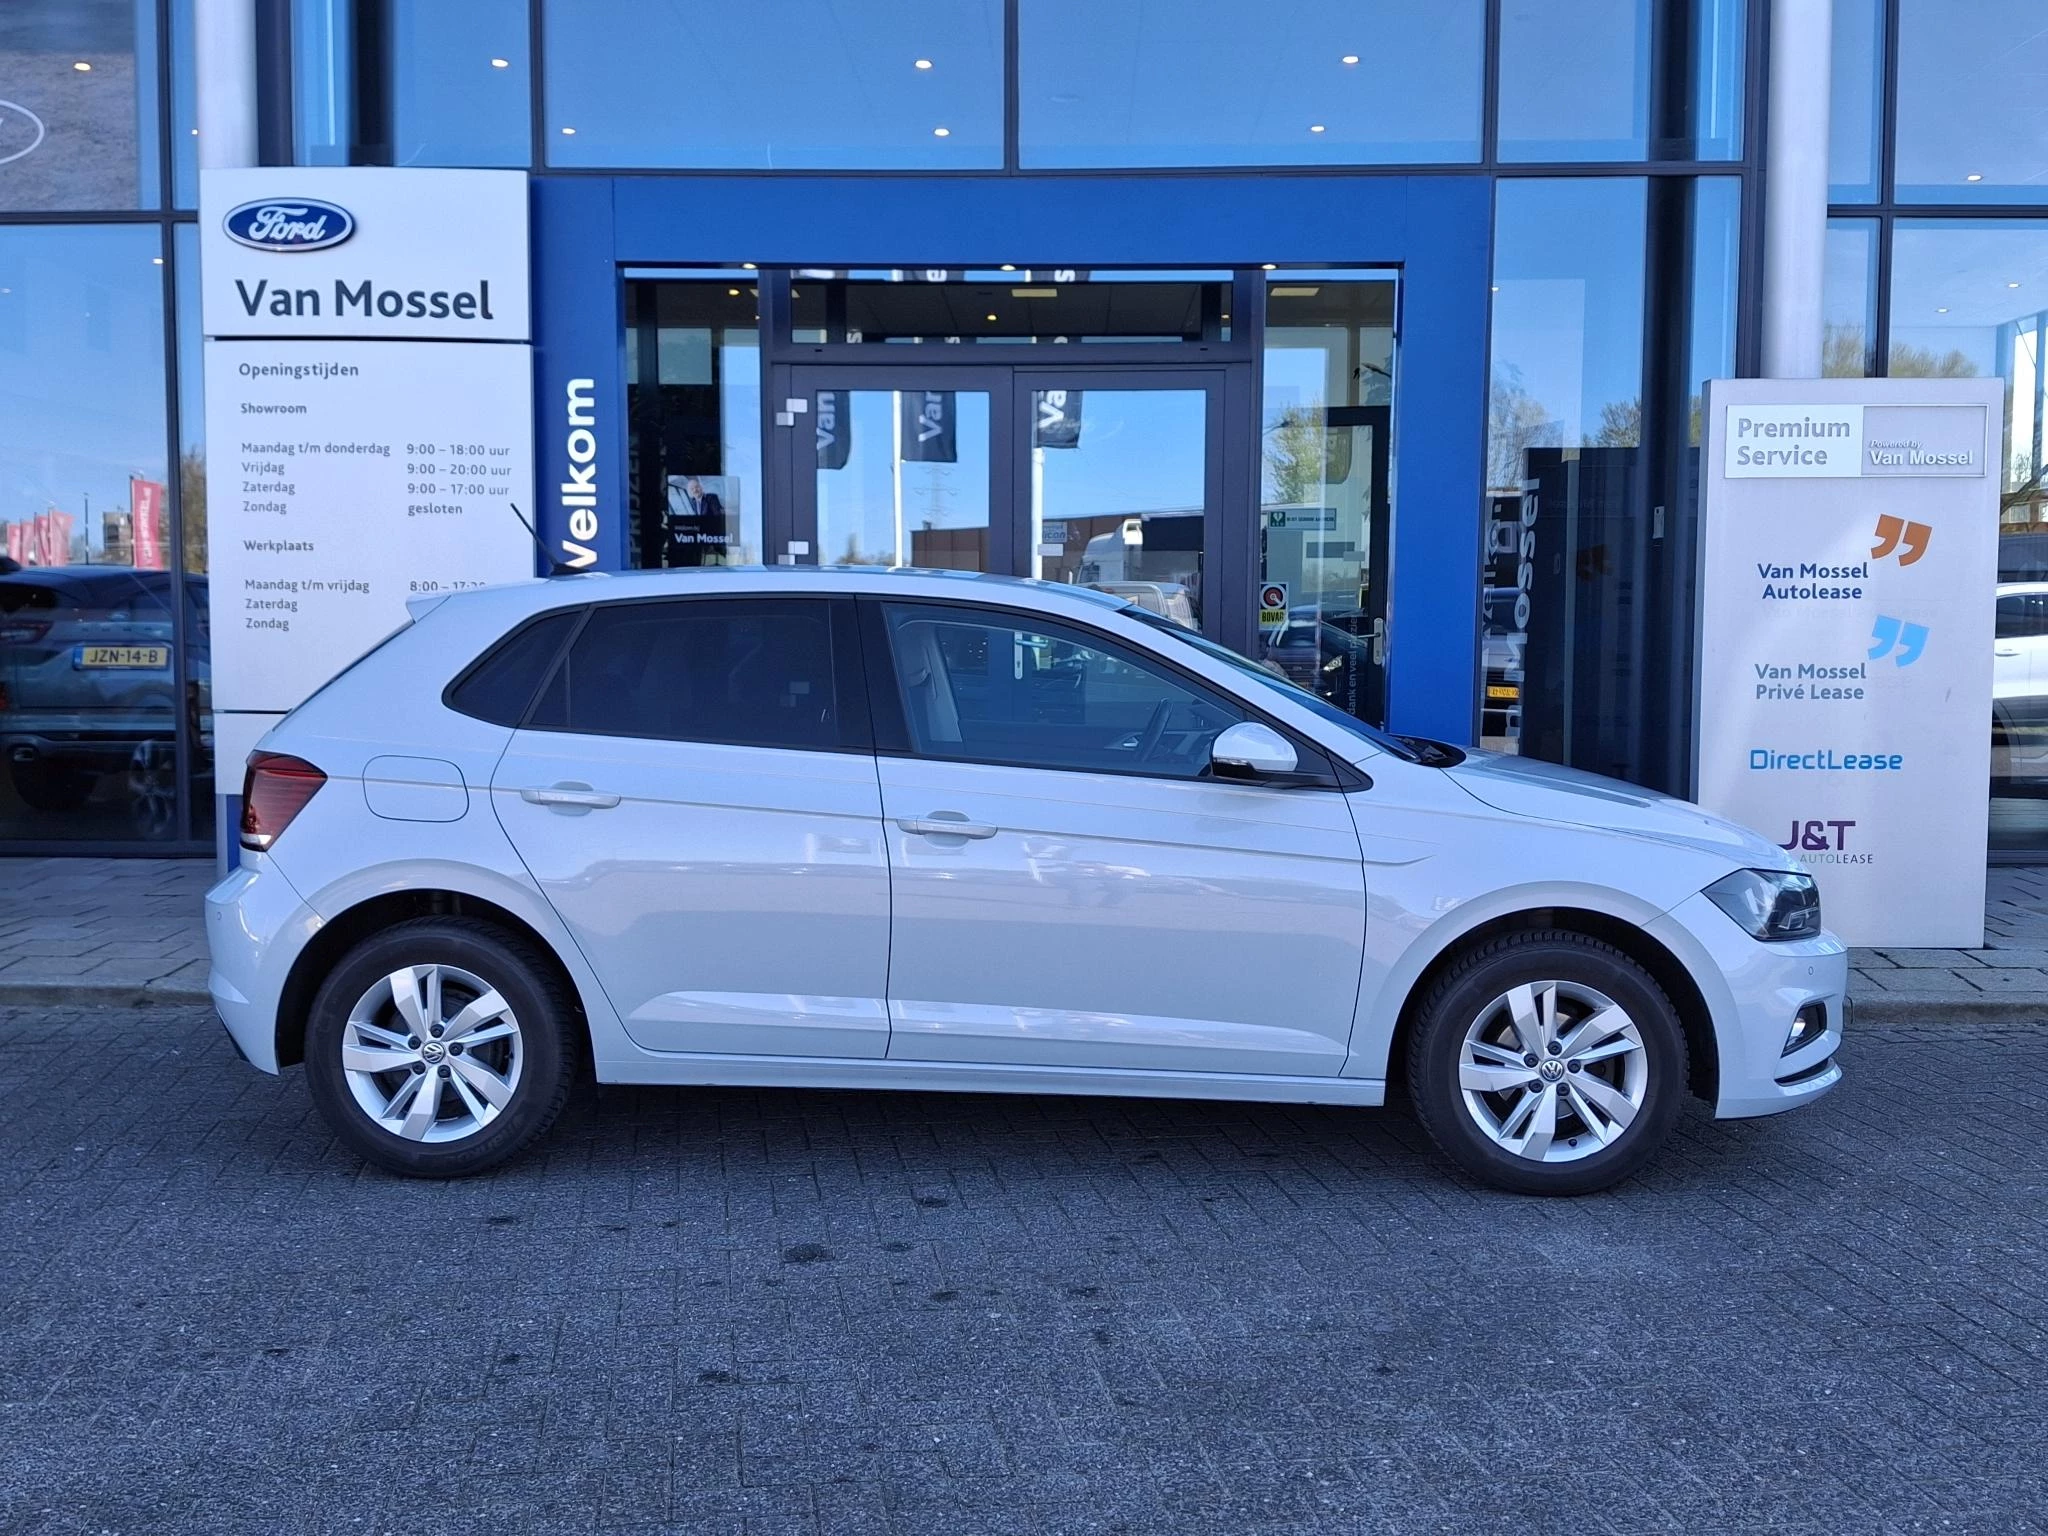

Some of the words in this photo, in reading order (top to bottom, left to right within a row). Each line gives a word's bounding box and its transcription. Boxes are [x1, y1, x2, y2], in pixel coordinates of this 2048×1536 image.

[248, 206, 327, 241] Ford
[235, 280, 320, 316] Van
[335, 280, 493, 320] Mossel
[239, 362, 359, 379] Openingstijden
[241, 402, 307, 415] Showroom
[1738, 417, 1850, 438] Premium
[242, 442, 295, 456] Maandag
[298, 443, 321, 454] t/m
[324, 442, 391, 457] donderdag
[406, 443, 435, 455] 9:00
[450, 444, 485, 456] 18:00
[489, 447, 511, 456] uur
[1871, 440, 1910, 448] Powered
[1911, 440, 1922, 449] by
[1737, 445, 1828, 465] Service
[1870, 450, 1904, 465] Van
[1909, 449, 1973, 465] Mossel
[241, 462, 285, 476] Vrijdag
[407, 463, 436, 474] 9:00
[450, 464, 487, 475] 20:00
[490, 467, 512, 476] uur
[242, 481, 295, 496] Zaterdag
[407, 483, 436, 494] 9:00
[450, 484, 485, 495] 17:00
[489, 486, 510, 495] uur
[243, 501, 287, 515] Zondag
[408, 502, 463, 517] gesloten
[674, 533, 694, 543] Van
[697, 532, 733, 543] Mossel
[243, 540, 315, 554] Werkplaats
[1757, 563, 1794, 579] Van
[1800, 562, 1869, 579] Mossel
[245, 579, 298, 593] Maandag
[302, 580, 324, 591] t/m
[327, 580, 370, 594] vrijdag
[409, 581, 439, 592] 8:00
[1503, 478, 1540, 682] Mossel
[1762, 583, 1863, 600] Autolease
[245, 598, 298, 612] Zaterdag
[245, 617, 290, 632] Zondag
[90, 650, 158, 664] JZN-14-B
[1755, 664, 1793, 679] Van
[1798, 663, 1867, 679] Mossel
[1756, 682, 1805, 700] Privé
[1810, 684, 1864, 700] Lease
[1751, 750, 1903, 770] DirectLease
[1777, 820, 1856, 851] J&T
[1800, 854, 1874, 864] AUTOLEASE
